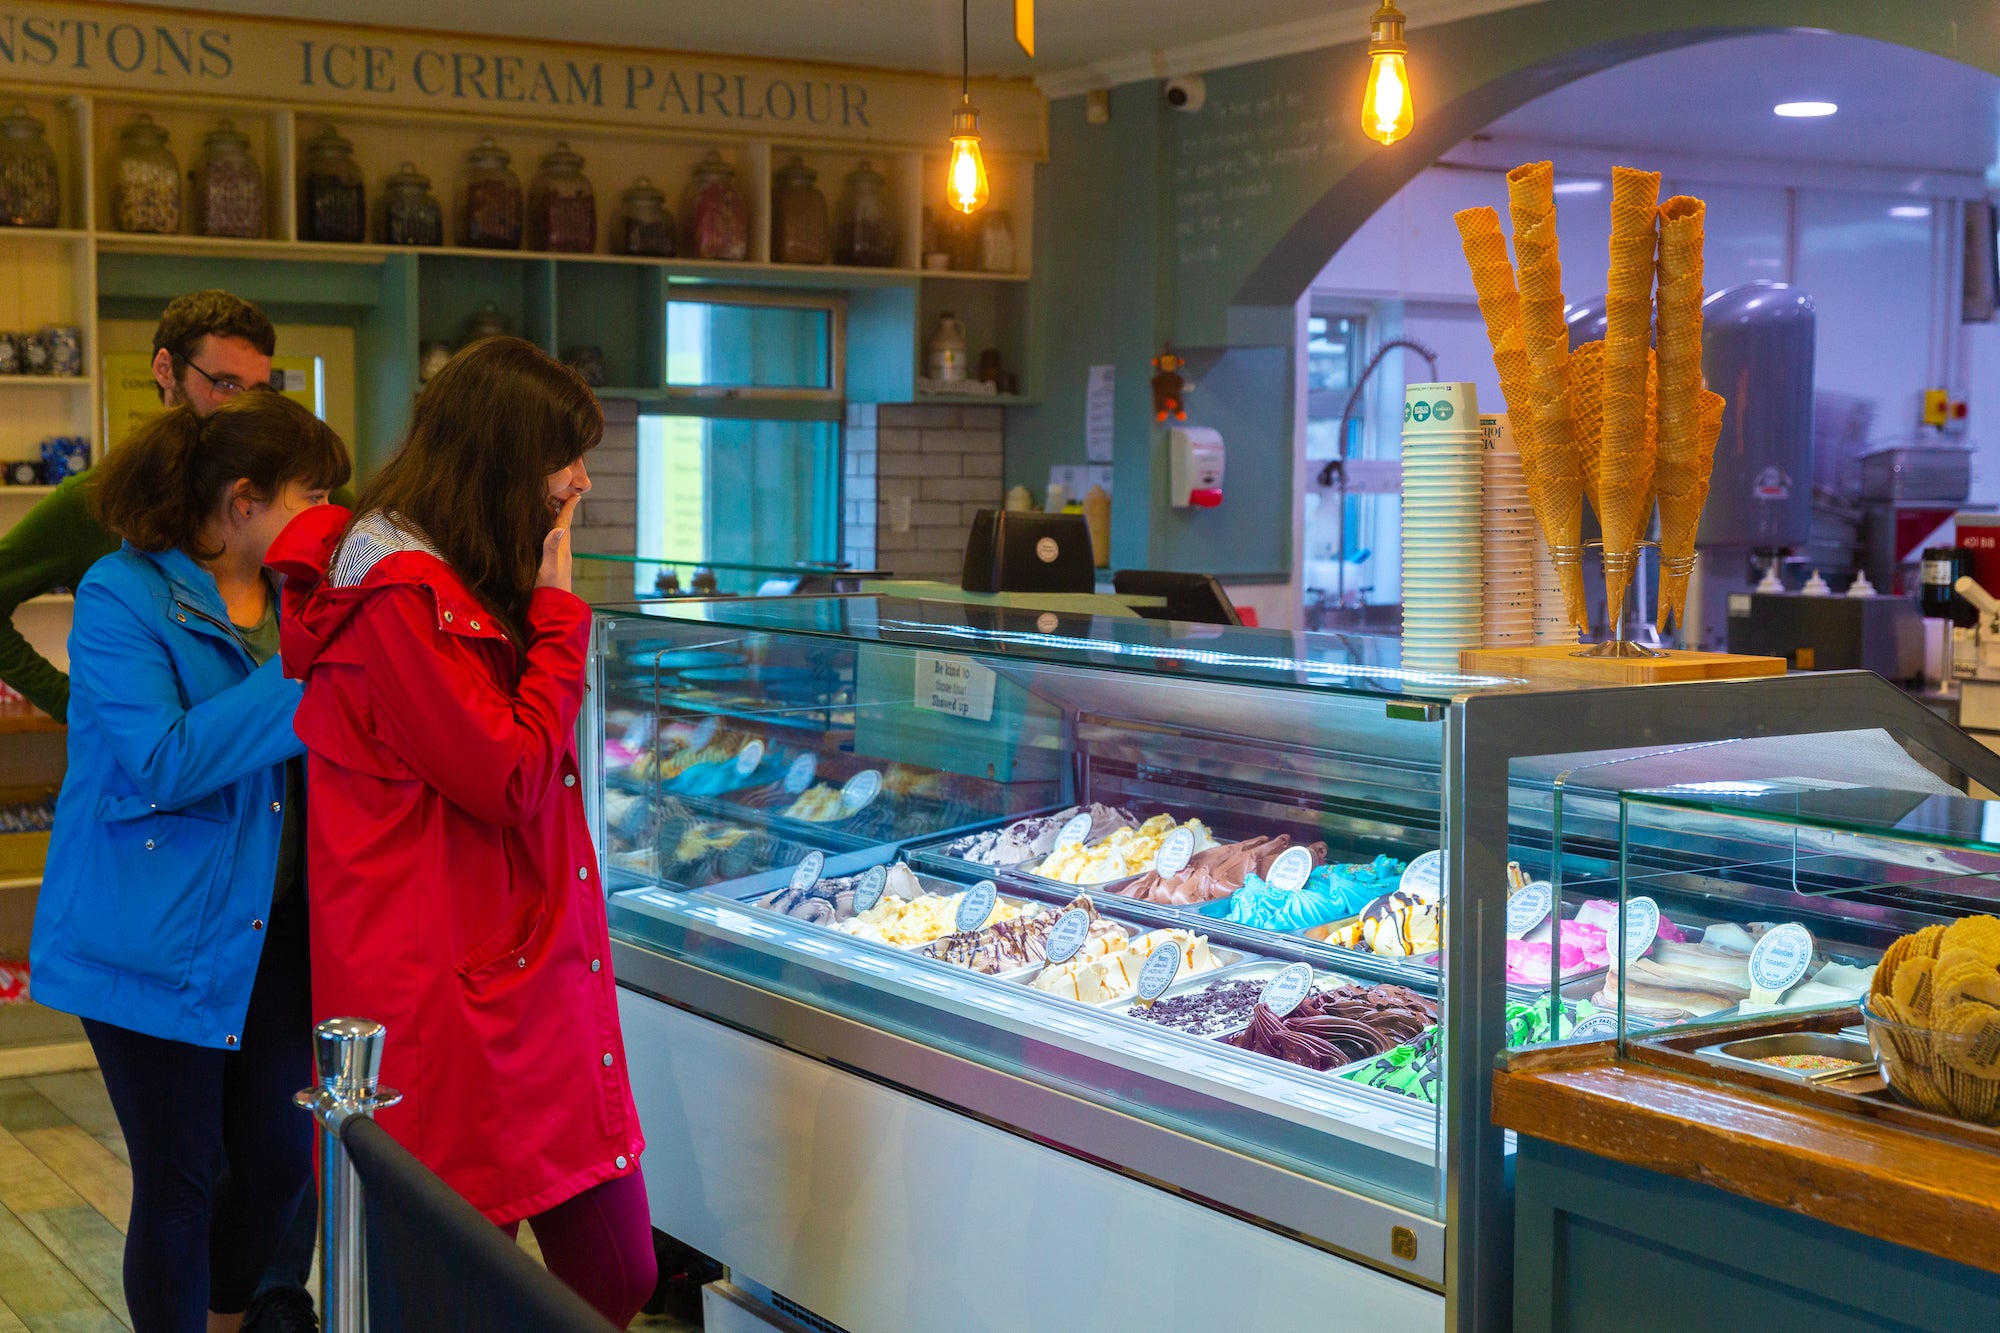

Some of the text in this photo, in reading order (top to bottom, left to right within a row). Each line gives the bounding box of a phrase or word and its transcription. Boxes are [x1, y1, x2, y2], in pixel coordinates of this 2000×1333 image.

[300, 40, 396, 93] ICE
[413, 49, 606, 108] CREAM
[624, 65, 873, 128] PARLOUR
[945, 663, 960, 677] kind
[959, 702, 969, 716] up
[1599, 1018, 1619, 1030] PARLO
